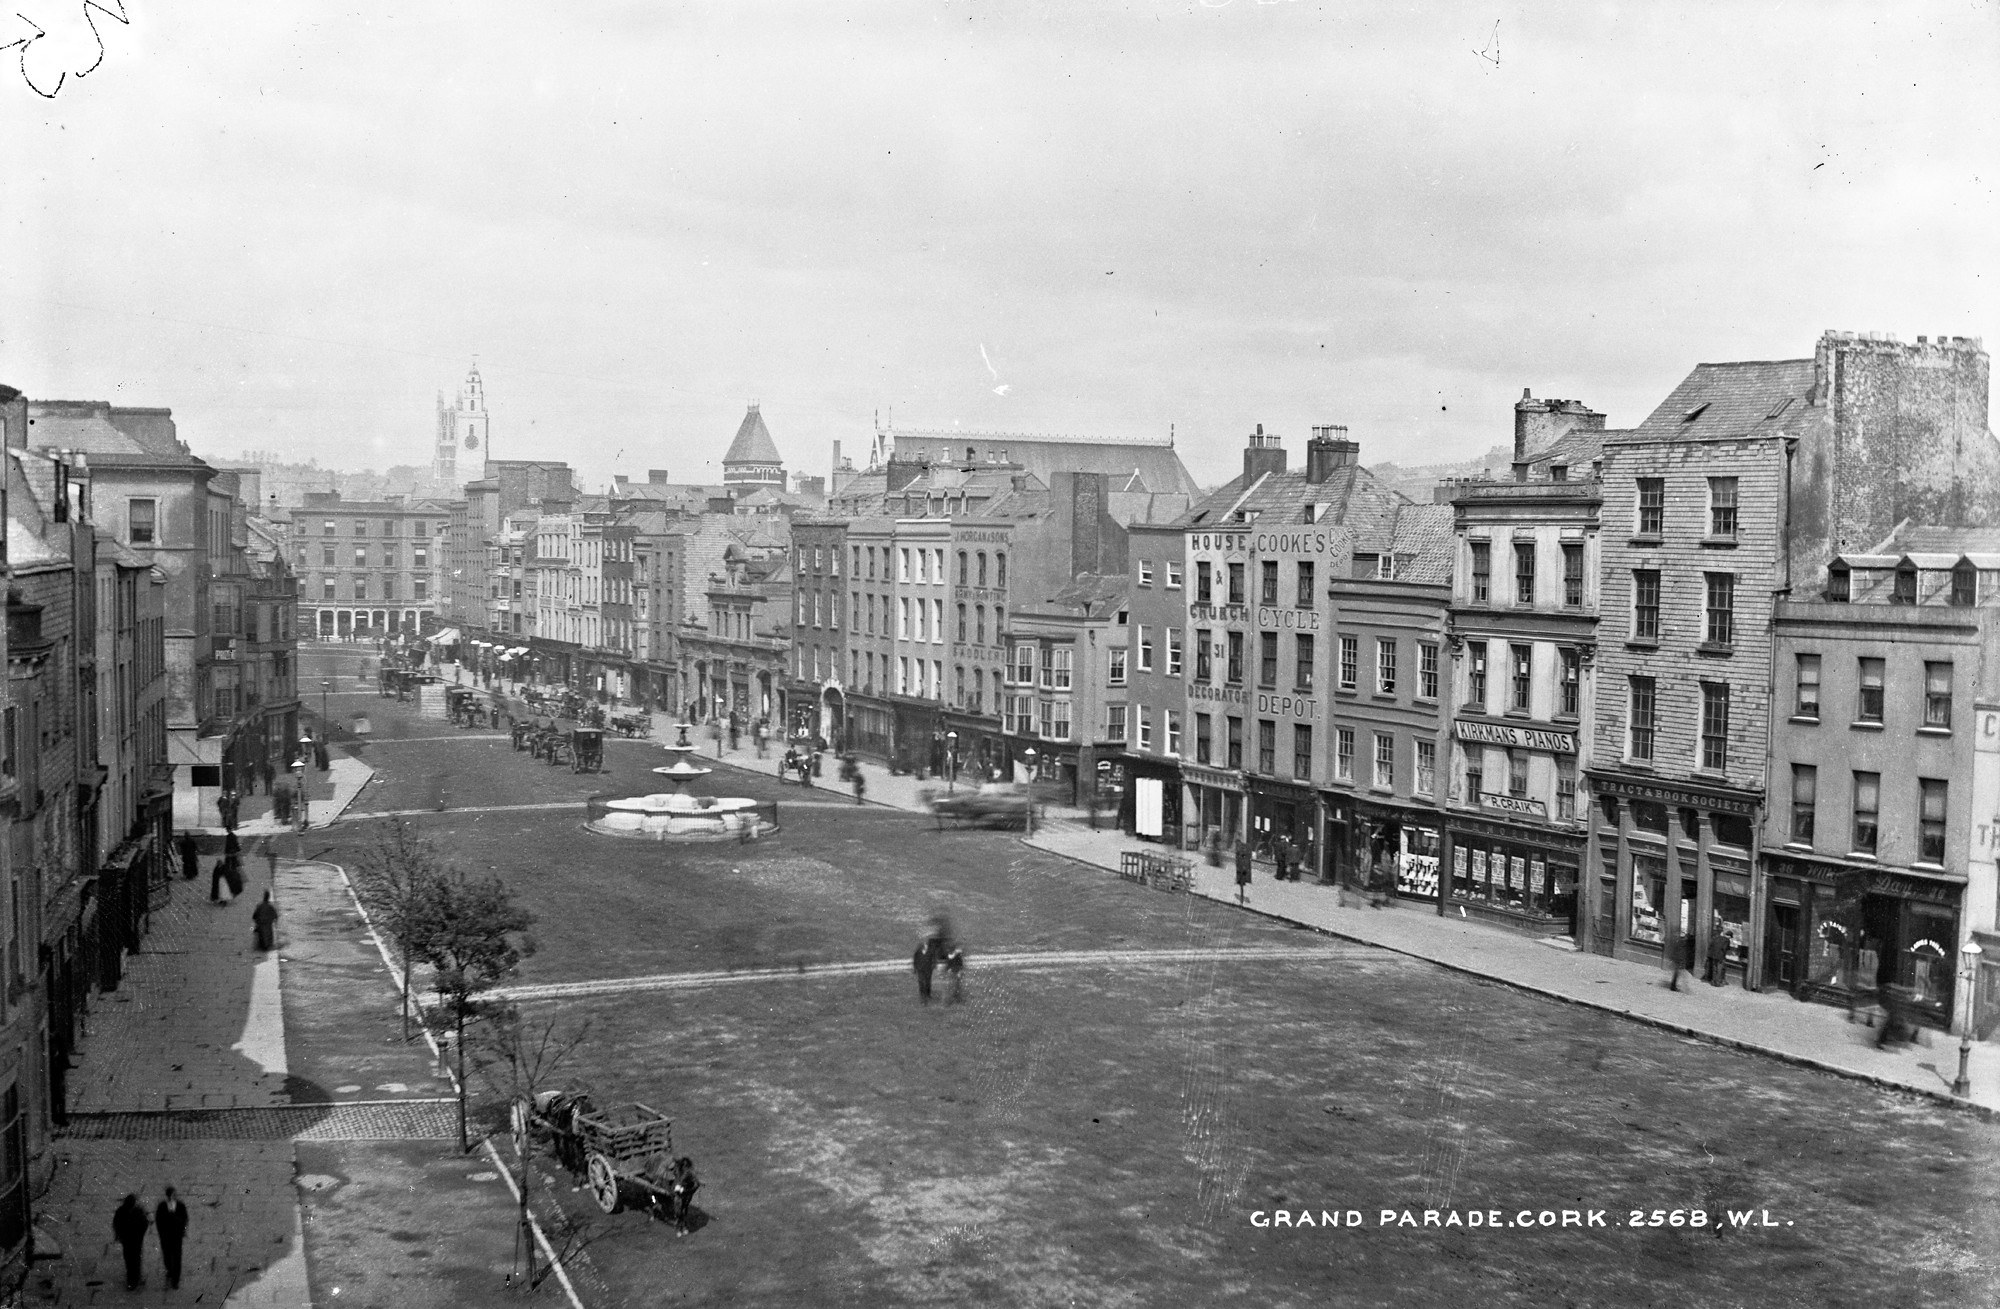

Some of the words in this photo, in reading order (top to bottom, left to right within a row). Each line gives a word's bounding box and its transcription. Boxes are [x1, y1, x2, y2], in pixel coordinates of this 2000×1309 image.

[1192, 535, 1246, 551] HOUSE
[1258, 530, 1325, 553] COOKE'S
[1216, 570, 1223, 585] &
[1190, 604, 1249, 622] CHURCH
[1258, 608, 1319, 630] CYCLE
[1214, 644, 1224, 658] 31
[1188, 684, 1249, 705] DECORATOR
[1525, 730, 1570, 751] PIANOS
[1601, 781, 1643, 795] TRACT
[1655, 789, 1689, 803] BOOK
[1691, 794, 1750, 813] SOCIETY
